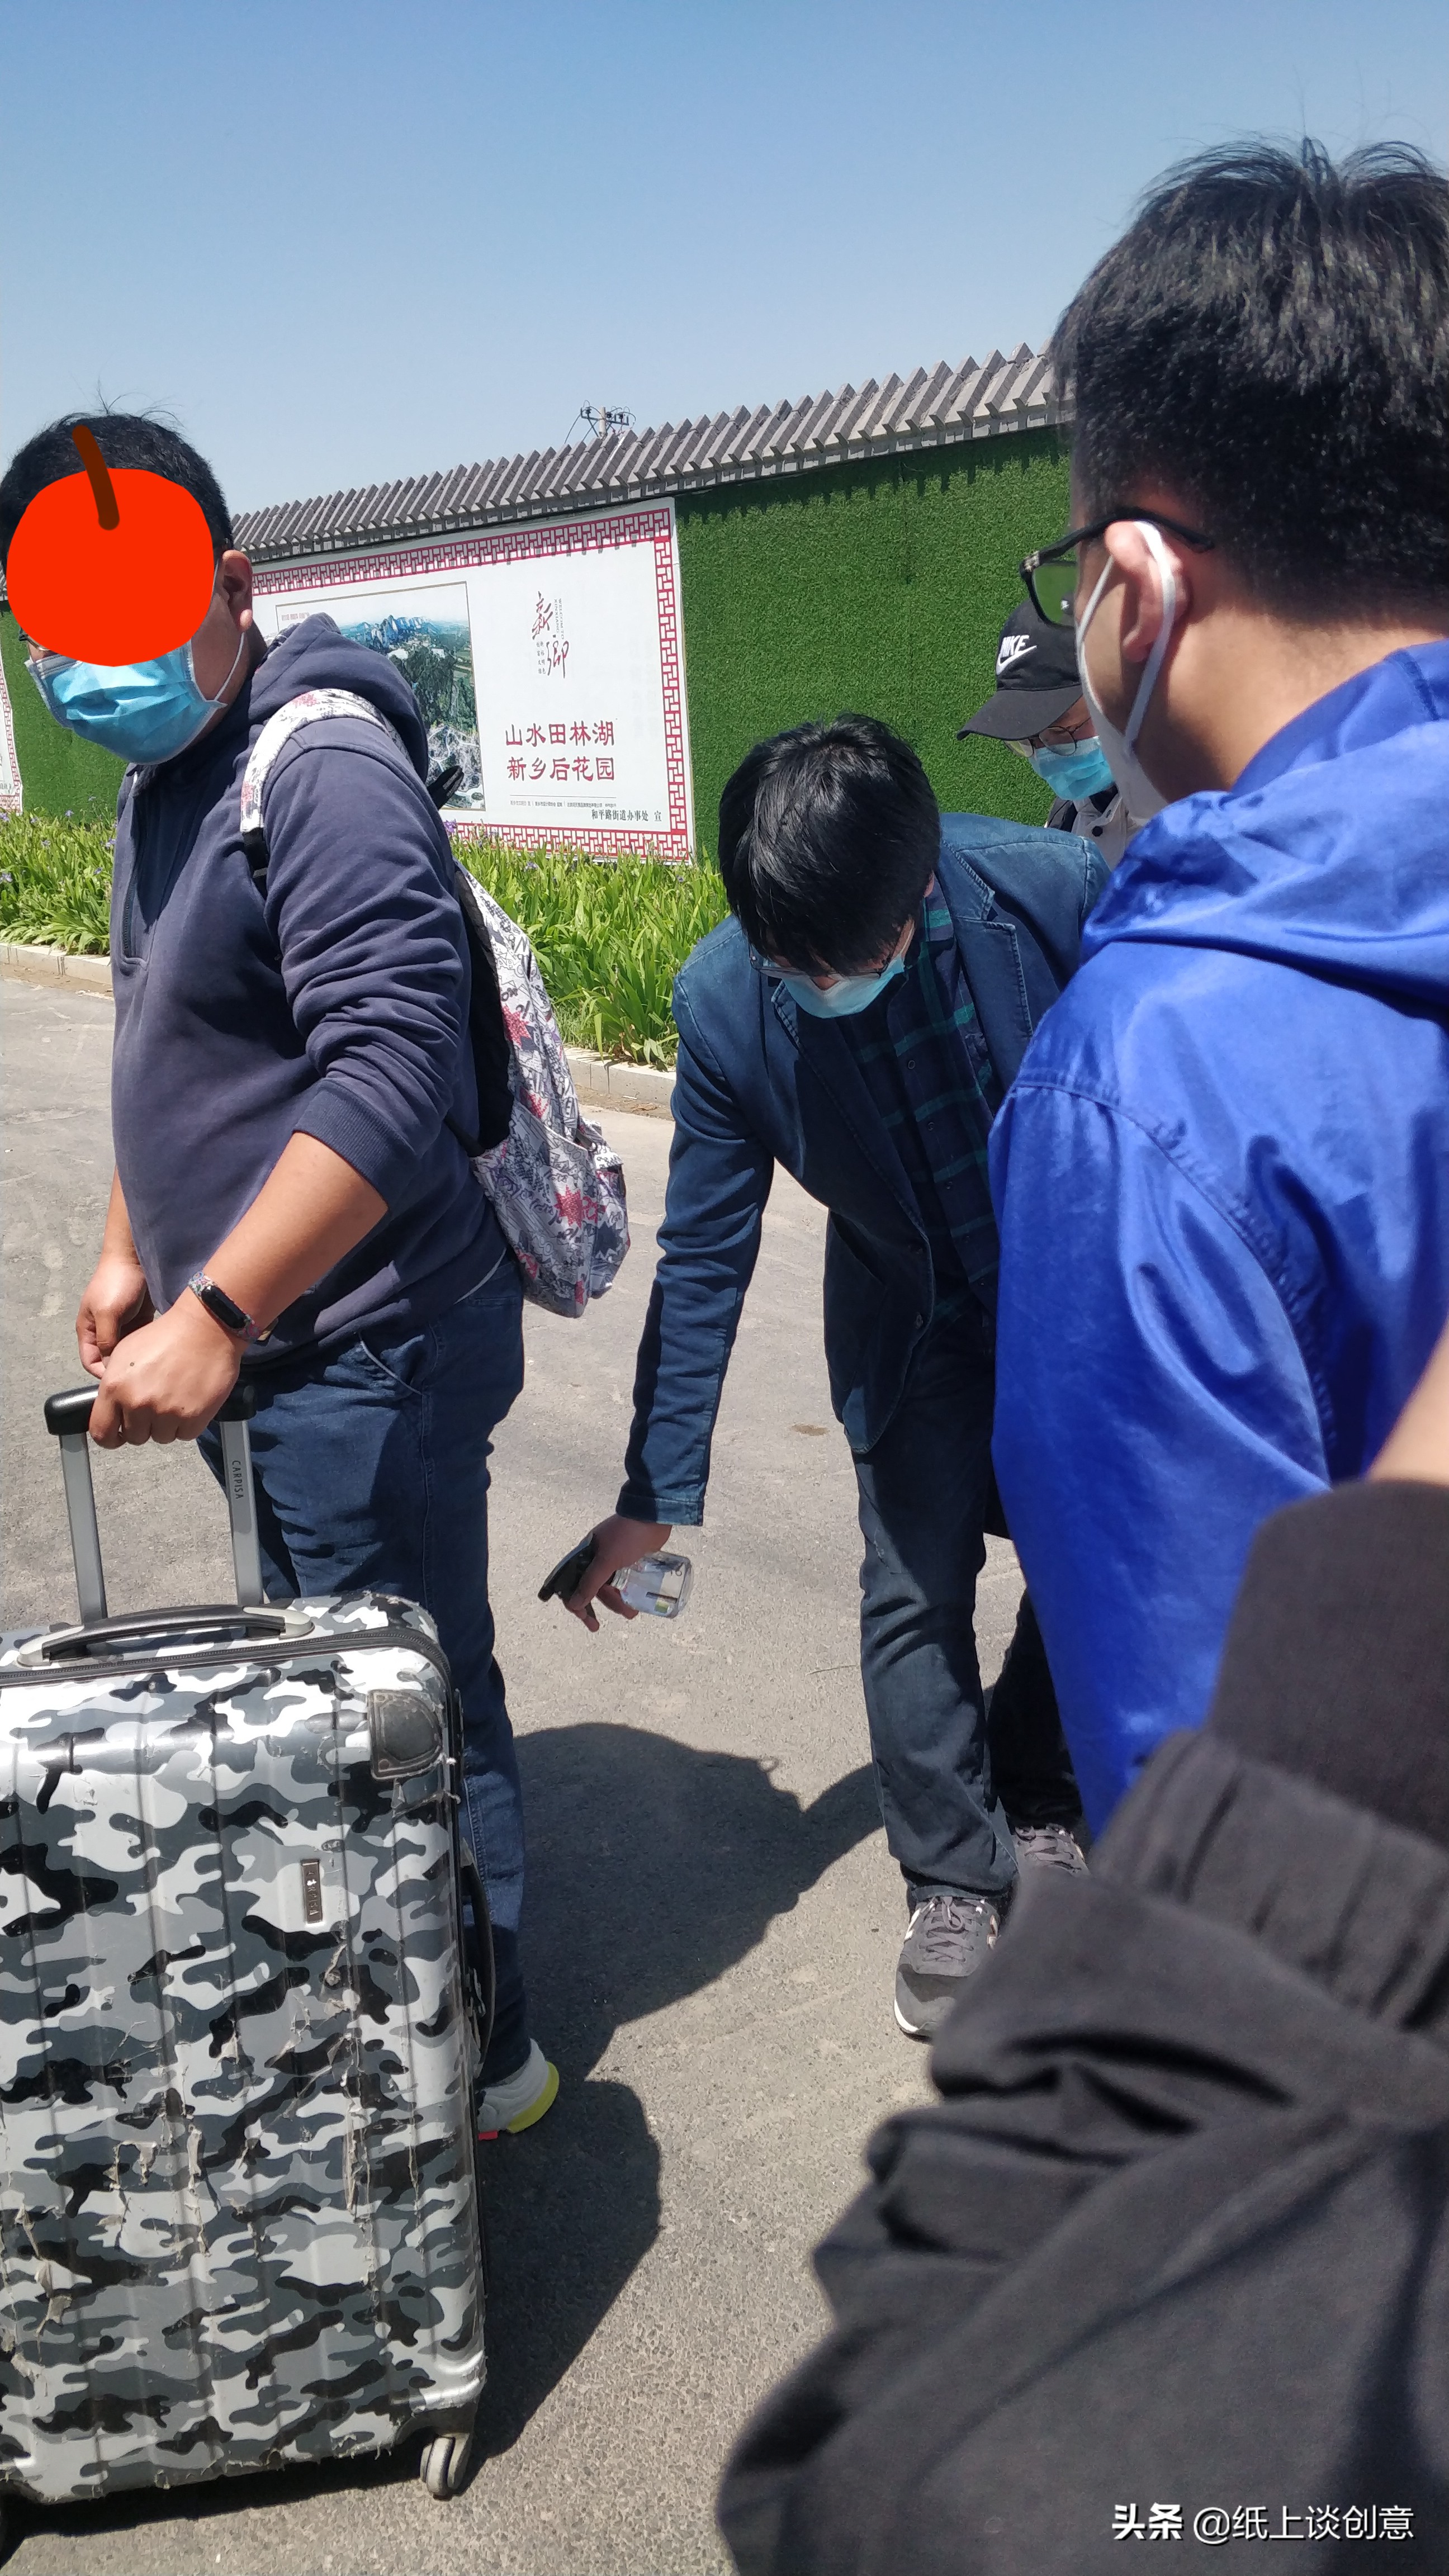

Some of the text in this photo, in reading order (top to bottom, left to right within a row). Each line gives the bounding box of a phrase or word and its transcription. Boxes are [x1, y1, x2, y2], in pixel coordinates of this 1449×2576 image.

[1000, 635, 1030, 657] NIKE
[505, 720, 614, 747] 山水田林湖
[507, 756, 614, 782] 新乡后花园
[591, 809, 662, 822] 和平路街道办事处 宣
[232, 1460, 244, 1499] CARPISA
